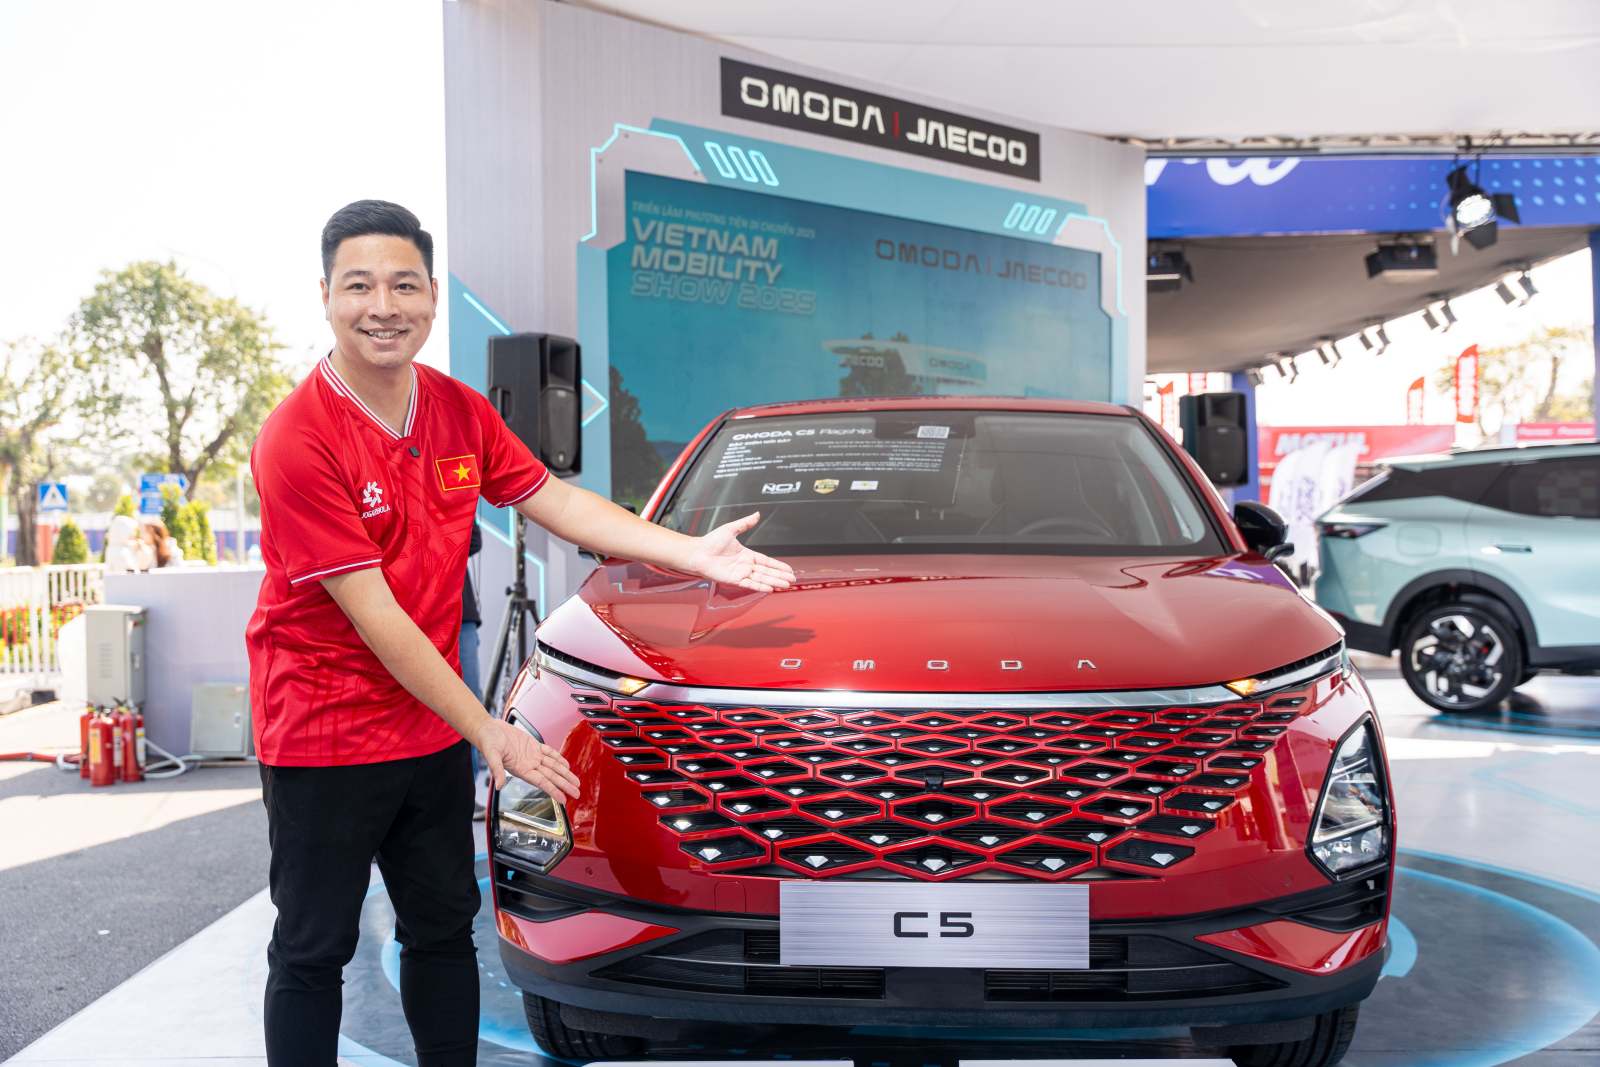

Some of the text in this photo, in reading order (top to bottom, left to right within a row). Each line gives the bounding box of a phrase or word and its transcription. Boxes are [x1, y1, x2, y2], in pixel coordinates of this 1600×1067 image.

[741, 76, 1027, 166] OMODA JAECOO
[632, 217, 779, 260] VIETNAM
[631, 244, 782, 285] MOBILITY
[875, 239, 1088, 290] OMODA JAECOO
[631, 270, 817, 315] SHOW 2025
[732, 430, 793, 441] OMODA
[780, 657, 1097, 671] OMODA
[893, 911, 975, 938] C5
